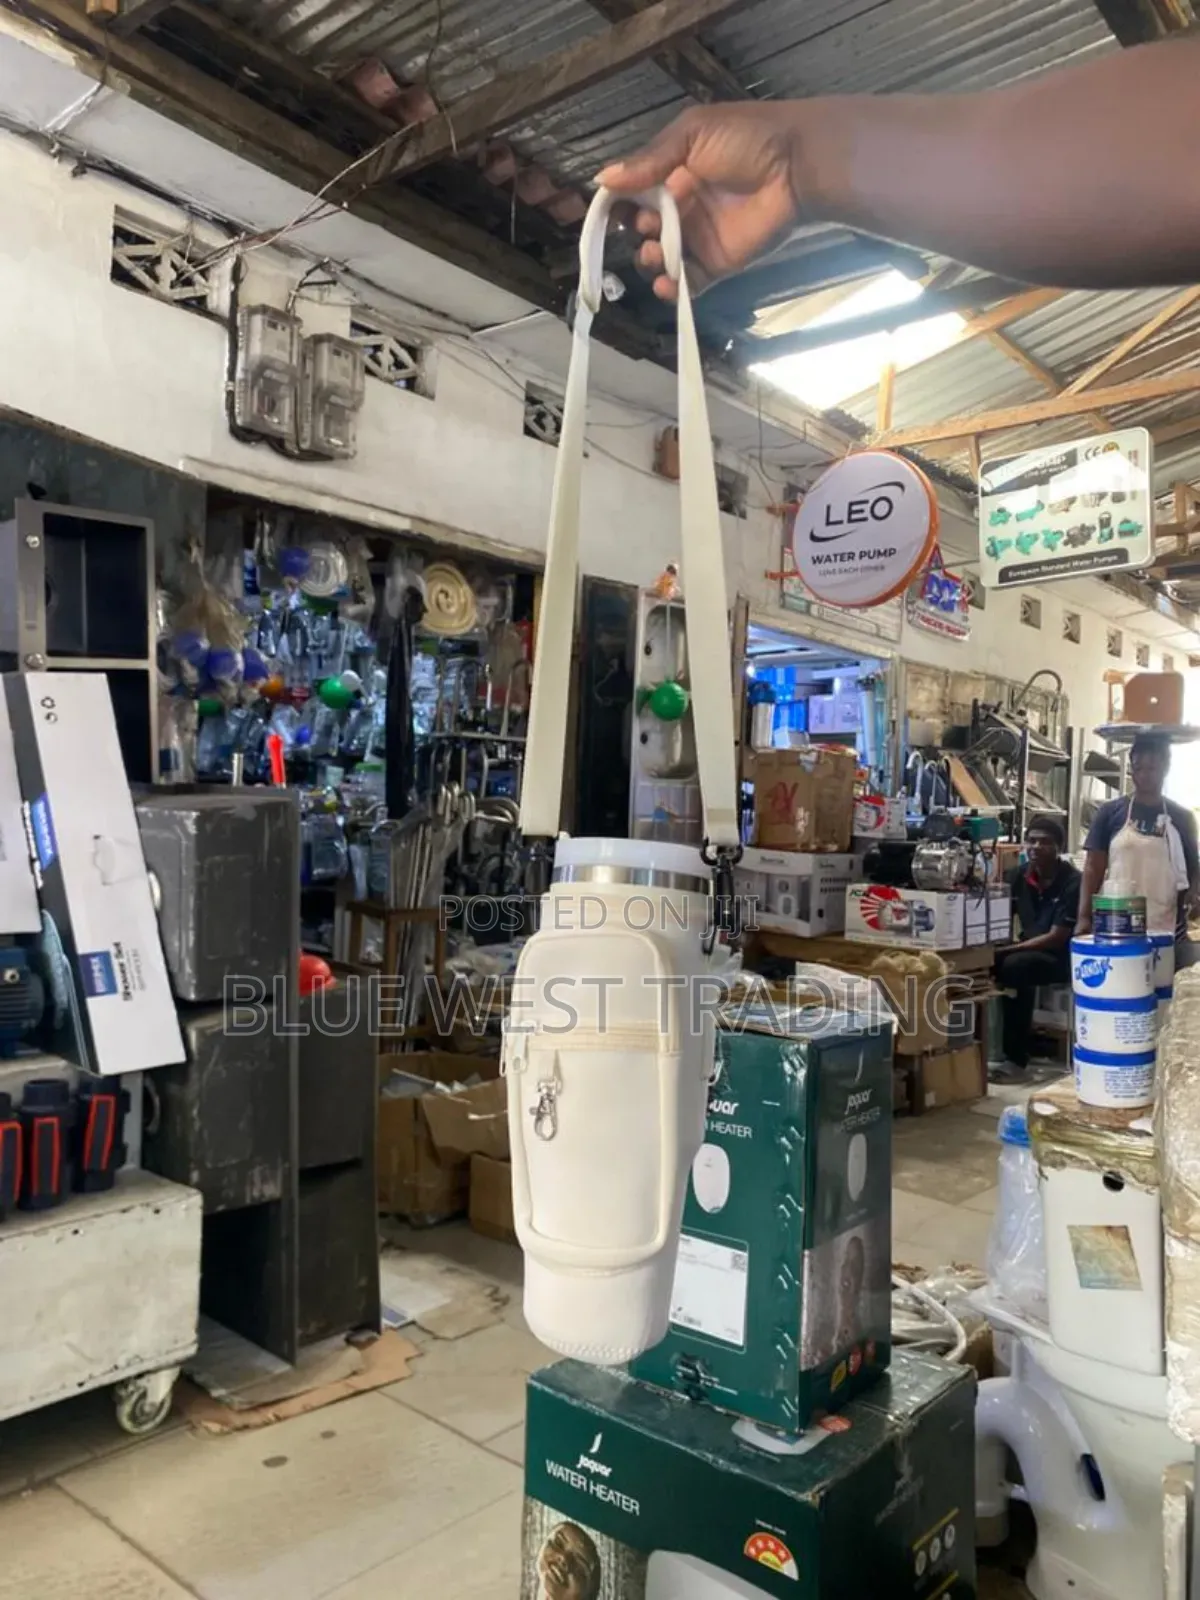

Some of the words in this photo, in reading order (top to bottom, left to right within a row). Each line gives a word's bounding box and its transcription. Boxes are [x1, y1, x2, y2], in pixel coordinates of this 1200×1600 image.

[824, 496, 893, 526] LEO
[811, 552, 856, 565] WATER
[858, 547, 897, 561] PUMP
[710, 1120, 753, 1139] HEATER
[545, 1458, 588, 1492] WATER
[589, 1480, 640, 1516] HEATER
